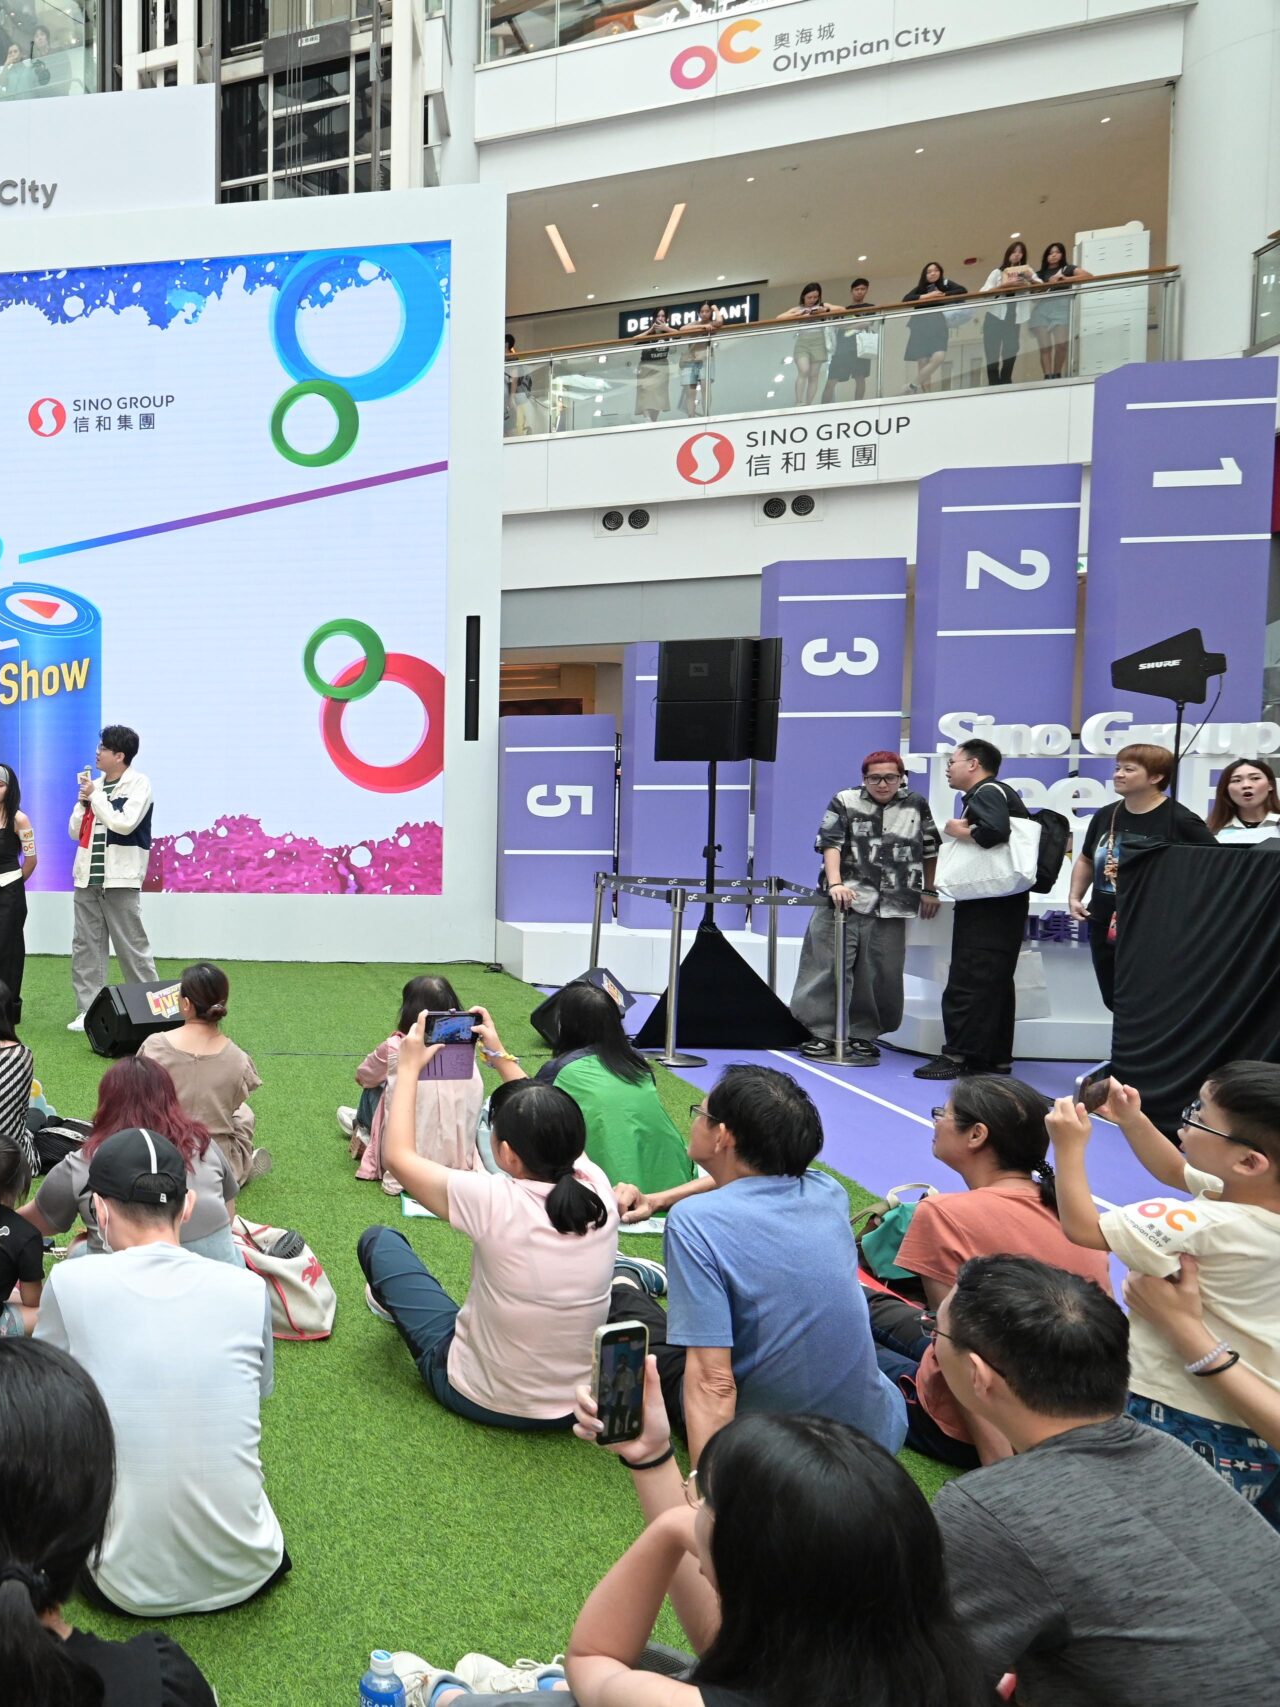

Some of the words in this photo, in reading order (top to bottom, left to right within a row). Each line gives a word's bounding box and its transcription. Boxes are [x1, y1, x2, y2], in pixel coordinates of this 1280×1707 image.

[772, 37, 890, 73] Olympian
[894, 25, 947, 50] City
[773, 22, 836, 51] 奧海城
[73, 398, 113, 412] SINO
[117, 394, 175, 410] GROUP
[73, 413, 155, 433] 信和集團
[745, 425, 808, 448] SINO
[815, 416, 911, 441] GROUP
[745, 442, 878, 478] 信和集團
[966, 549, 1051, 591] 2
[800, 637, 880, 676] 3
[1138, 659, 1182, 670] SHURE
[936, 711, 1071, 756] Sino
[1081, 711, 1280, 762] Group
[527, 782, 593, 818] 5
